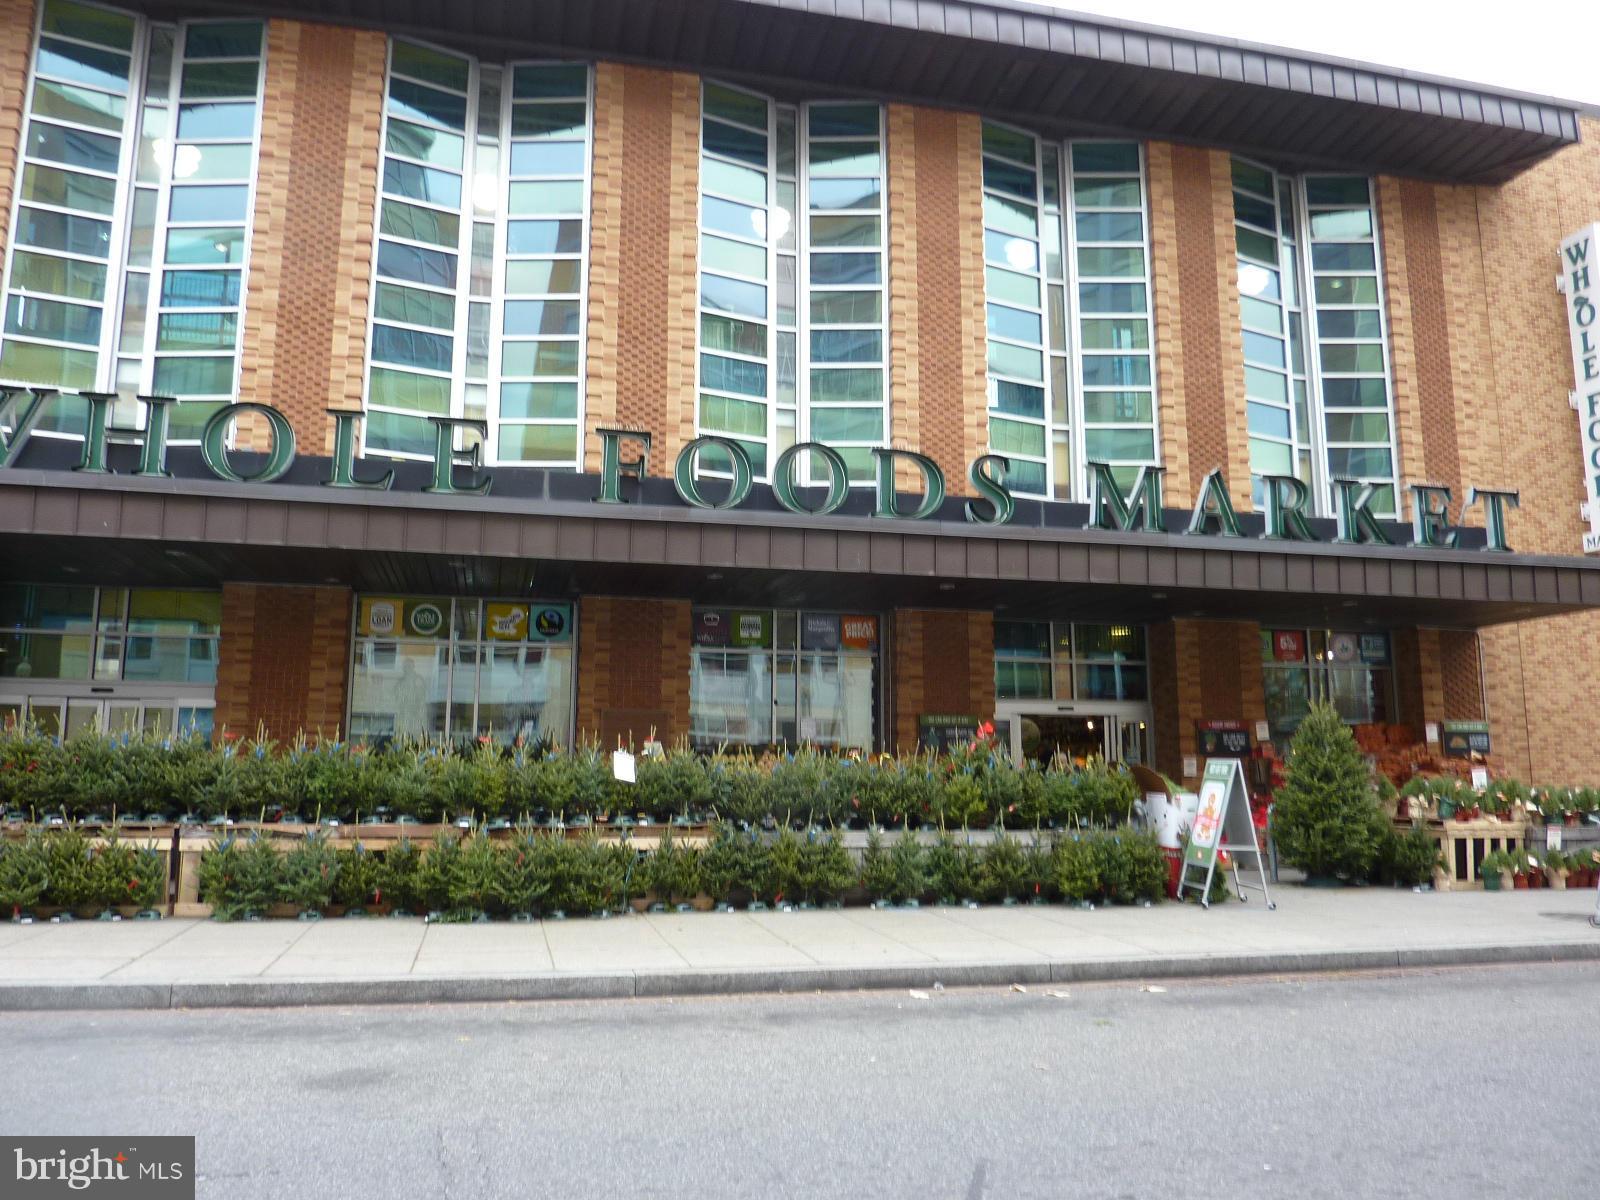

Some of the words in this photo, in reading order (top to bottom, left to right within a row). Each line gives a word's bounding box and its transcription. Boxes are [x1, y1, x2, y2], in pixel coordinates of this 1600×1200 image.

[1565, 238, 1600, 381] WHOLE
[591, 427, 1016, 527] FOODS
[1083, 461, 1520, 553] MARKET
